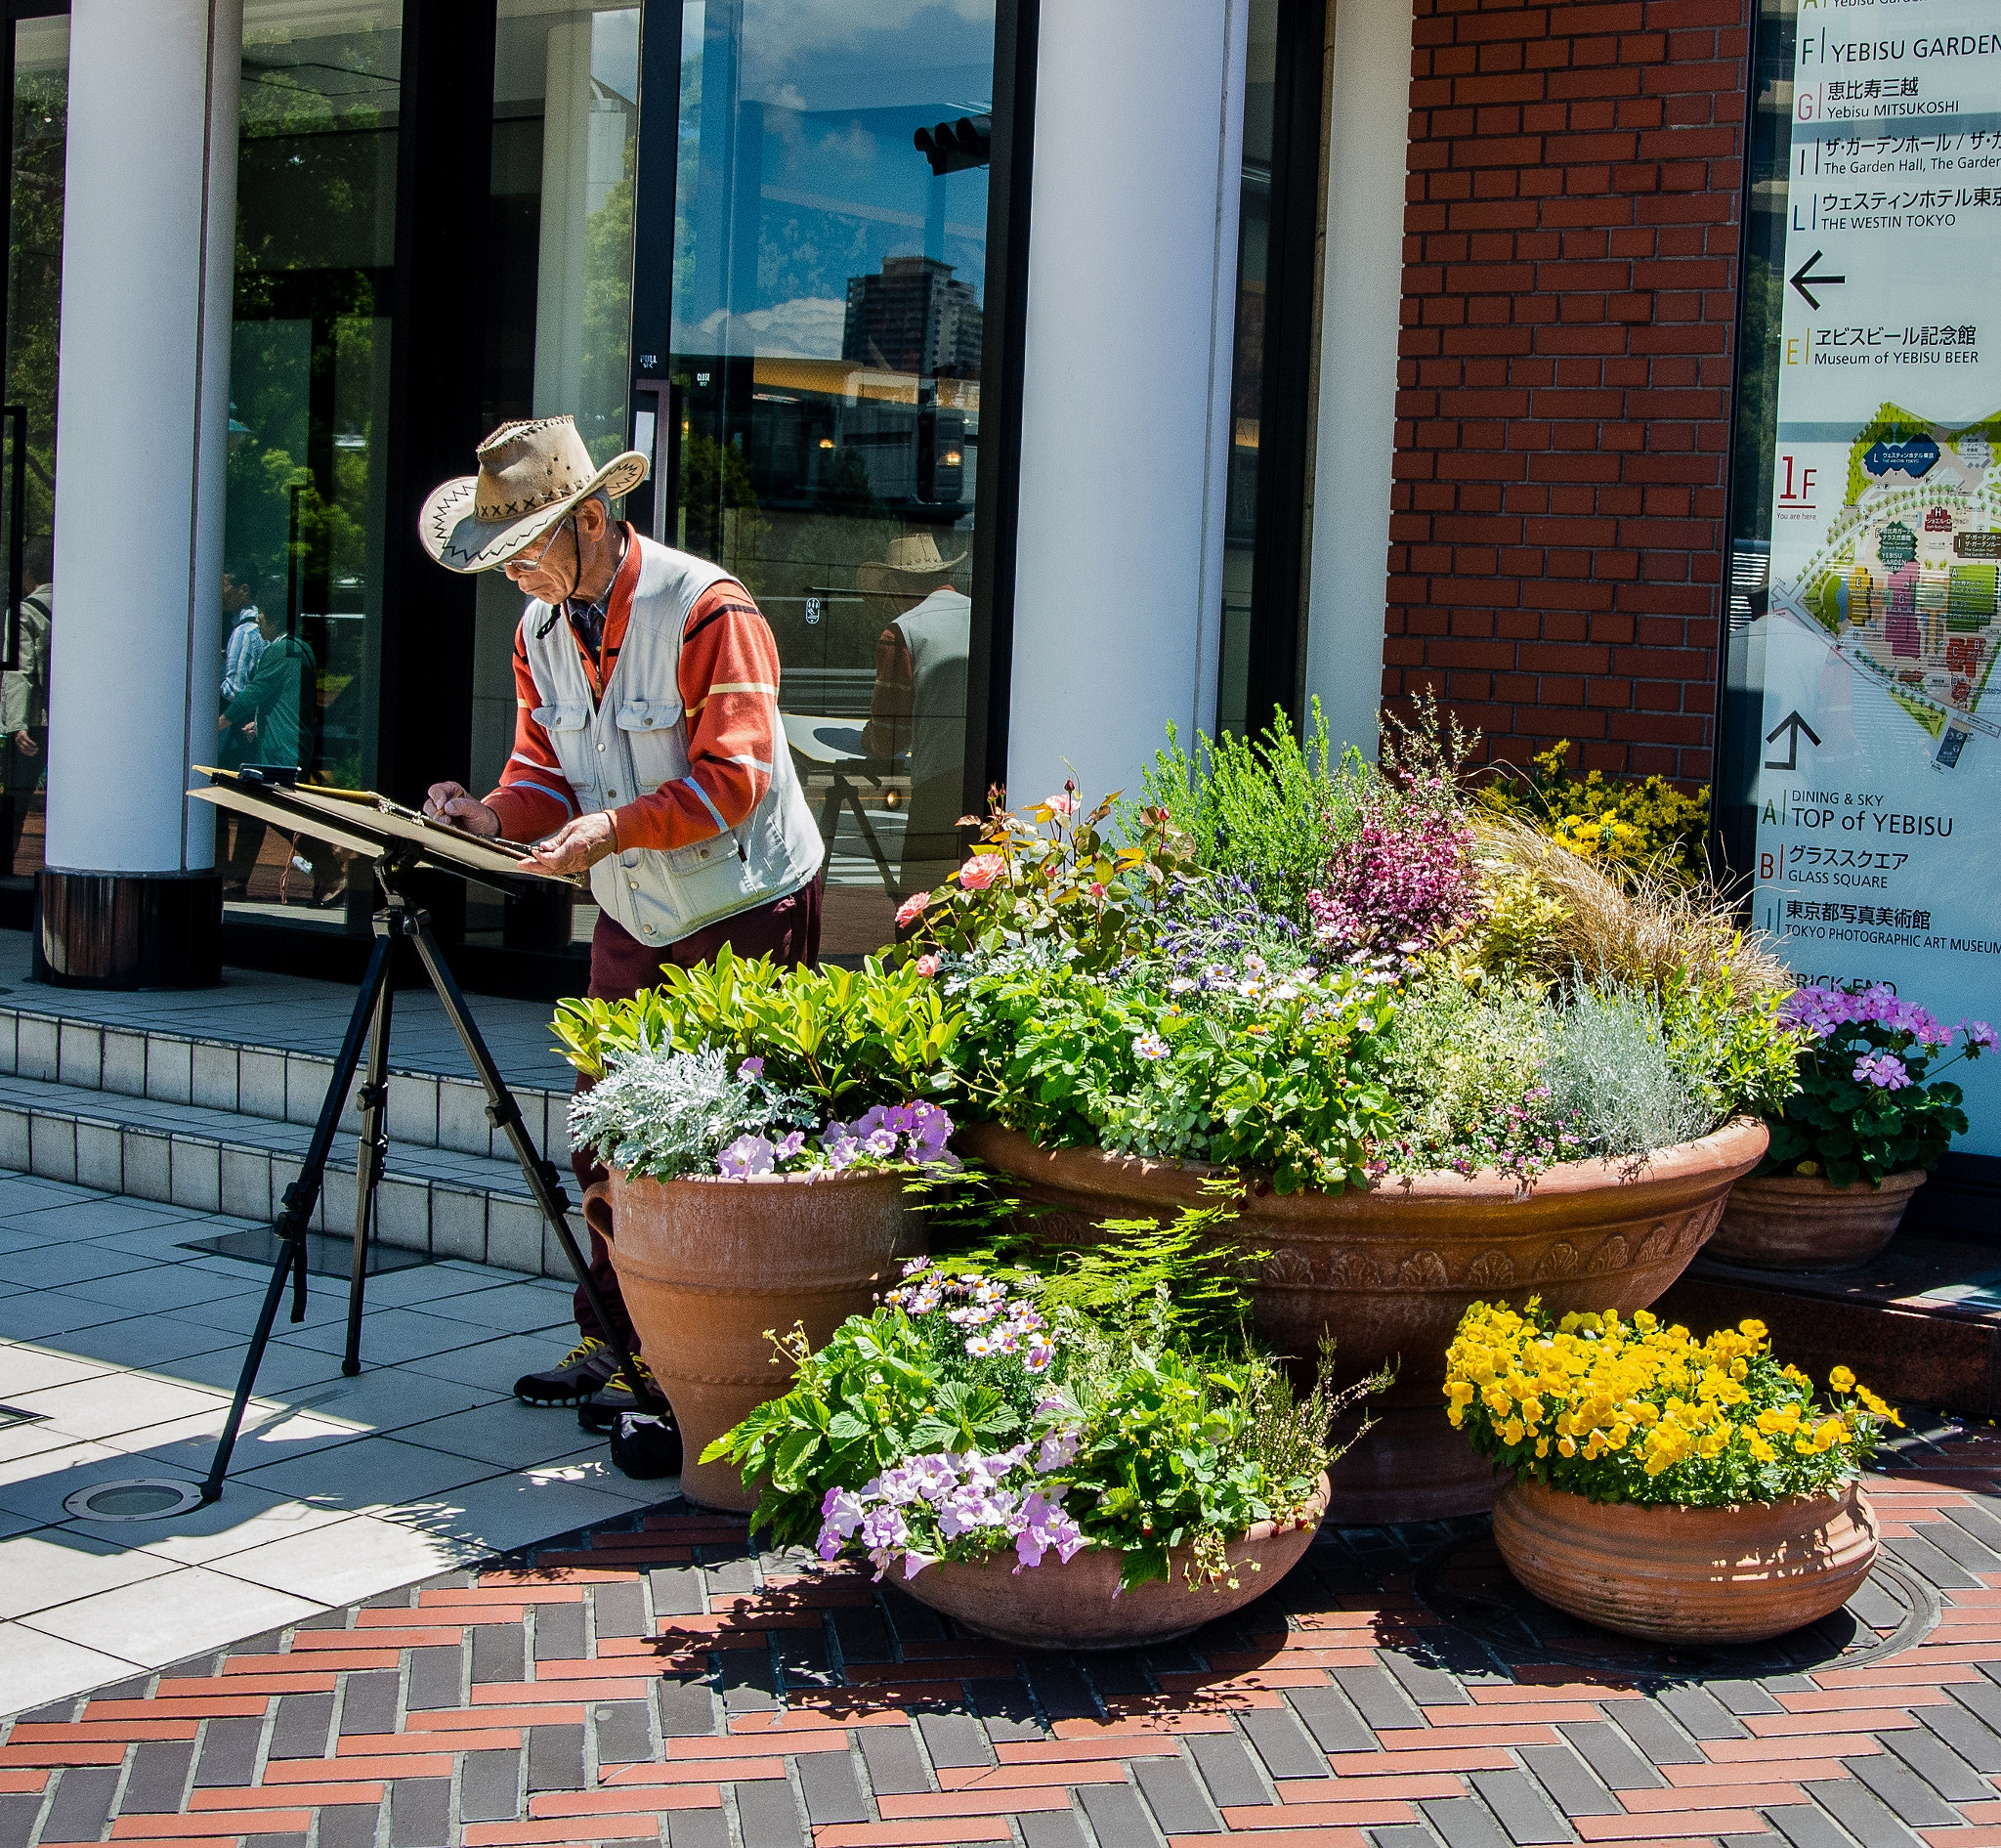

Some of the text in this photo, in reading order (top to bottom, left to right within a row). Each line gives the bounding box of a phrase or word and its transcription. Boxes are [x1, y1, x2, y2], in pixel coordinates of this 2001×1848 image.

[1801, 38, 1815, 65] F
[1831, 33, 2001, 64] YEBISU GARDEN
[1827, 76, 1920, 101] 恵比寿三越
[1797, 94, 1813, 120] G
[1827, 100, 1959, 119] Yebisu MITSUKOSHI
[1825, 133, 1951, 157] ザ・ガーデンホール
[1823, 162, 1846, 175] The
[1850, 160, 1895, 173] Garden
[1898, 157, 1926, 173] Hall,
[1931, 156, 1953, 170] The
[1793, 204, 1806, 232] L
[1821, 213, 1956, 231] THE WESTIN TOKYO
[1786, 338, 1800, 365] E
[1814, 351, 1979, 365] Museum of YEBISU BEER
[1802, 512, 1816, 521] here
[1792, 790, 1884, 807] DINING & SKY
[1762, 798, 1777, 826] A
[1791, 808, 1953, 838] TOP of YEBISU
[1760, 852, 1774, 880] B
[1789, 844, 1909, 871] グラススクエア
[1789, 870, 1888, 888] GLASS SQUARE
[1786, 899, 1932, 931] 東京都写真美術館
[1785, 924, 2001, 955] TOKYO PHOTOGRAPHIC ART MUSEUM
